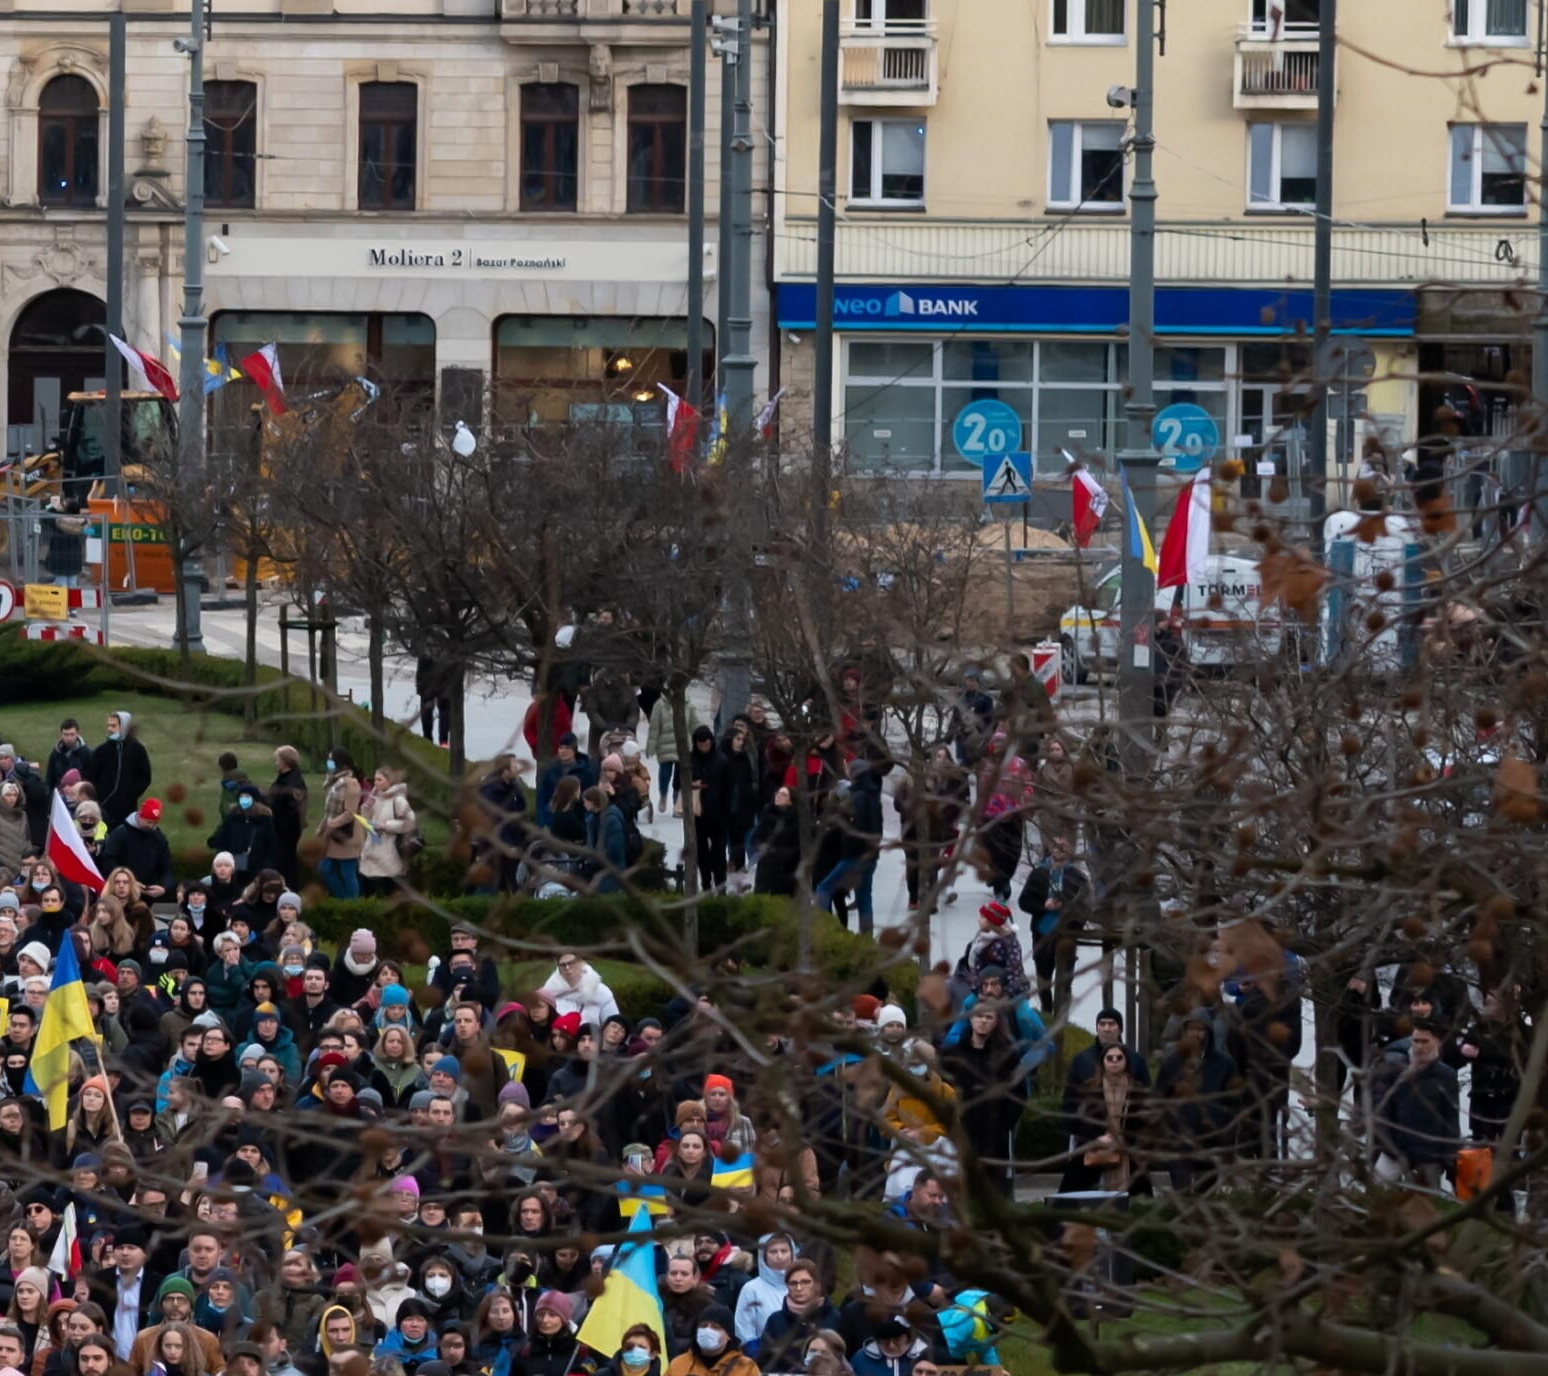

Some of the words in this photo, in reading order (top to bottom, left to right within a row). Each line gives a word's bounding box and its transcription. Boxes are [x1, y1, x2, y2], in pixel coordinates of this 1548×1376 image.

[368, 249, 444, 267] Moliera
[451, 250, 463, 266] 2
[475, 258, 507, 268] Bazar
[511, 256, 566, 269] Poznański
[919, 299, 978, 315] BANK
